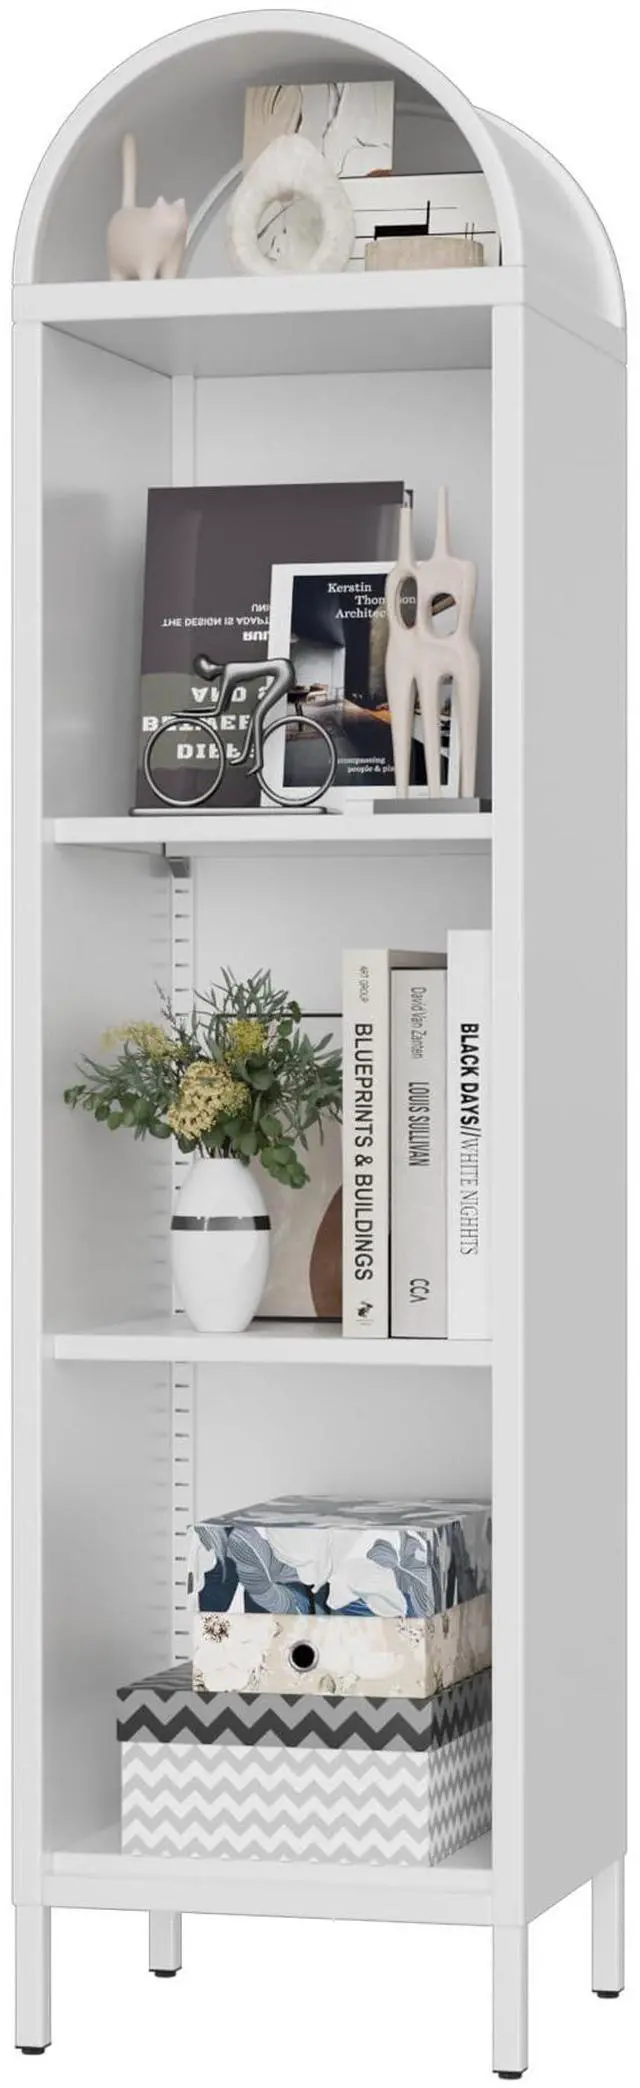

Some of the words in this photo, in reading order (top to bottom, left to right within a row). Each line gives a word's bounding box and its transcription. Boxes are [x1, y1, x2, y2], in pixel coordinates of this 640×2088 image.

[327, 582, 372, 593] Kerstin
[354, 594, 416, 605] Thomon
[335, 607, 387, 619] Architec
[410, 986, 427, 1011] David
[410, 1011, 426, 1029] Van
[459, 1022, 480, 1078] BLACK
[354, 1023, 374, 1148] BLUEPRINTS
[407, 1081, 430, 1113] LOUIS
[407, 1115, 431, 1167] SULLIVAN
[354, 1154, 374, 1168] &
[354, 1174, 374, 1281] BUILDINGS
